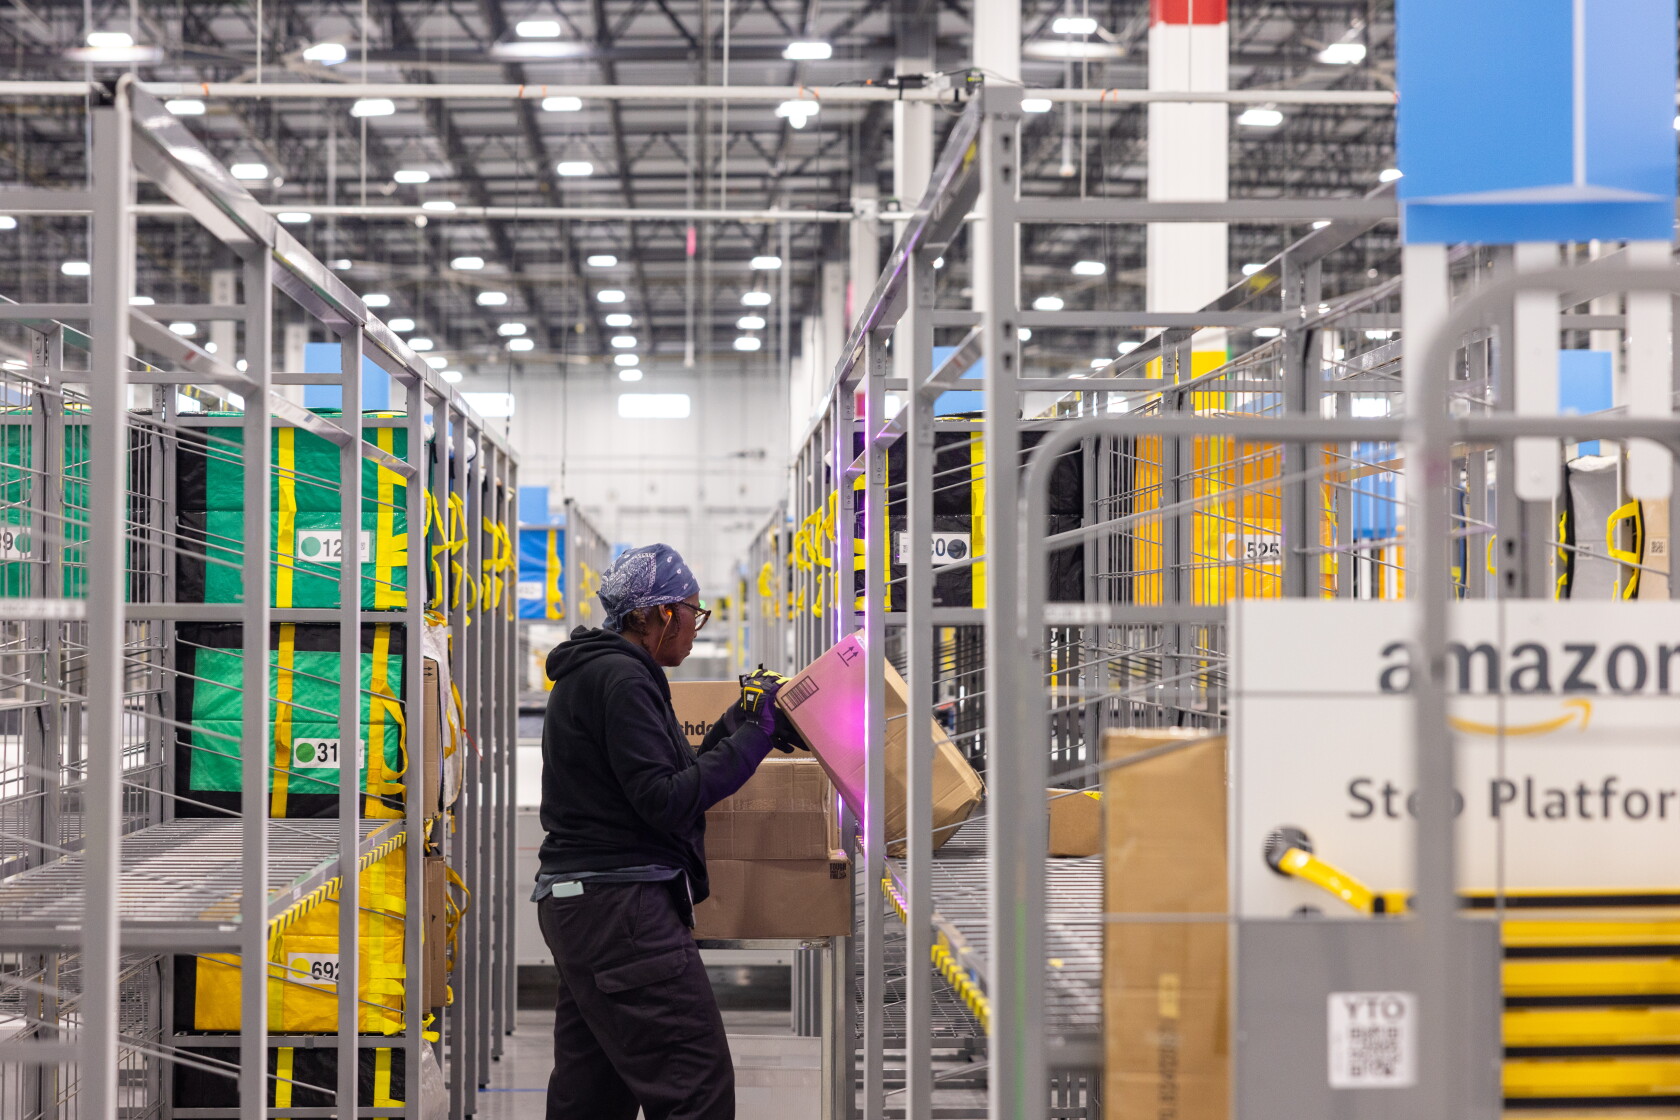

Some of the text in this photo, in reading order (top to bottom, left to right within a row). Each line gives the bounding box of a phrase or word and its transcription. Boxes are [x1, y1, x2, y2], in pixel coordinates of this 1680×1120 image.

[0, 531, 14, 551] 9
[931, 537, 946, 557] 0
[1247, 541, 1280, 559] 525
[317, 742, 338, 762] 31
[1347, 774, 1680, 820] St Platfor
